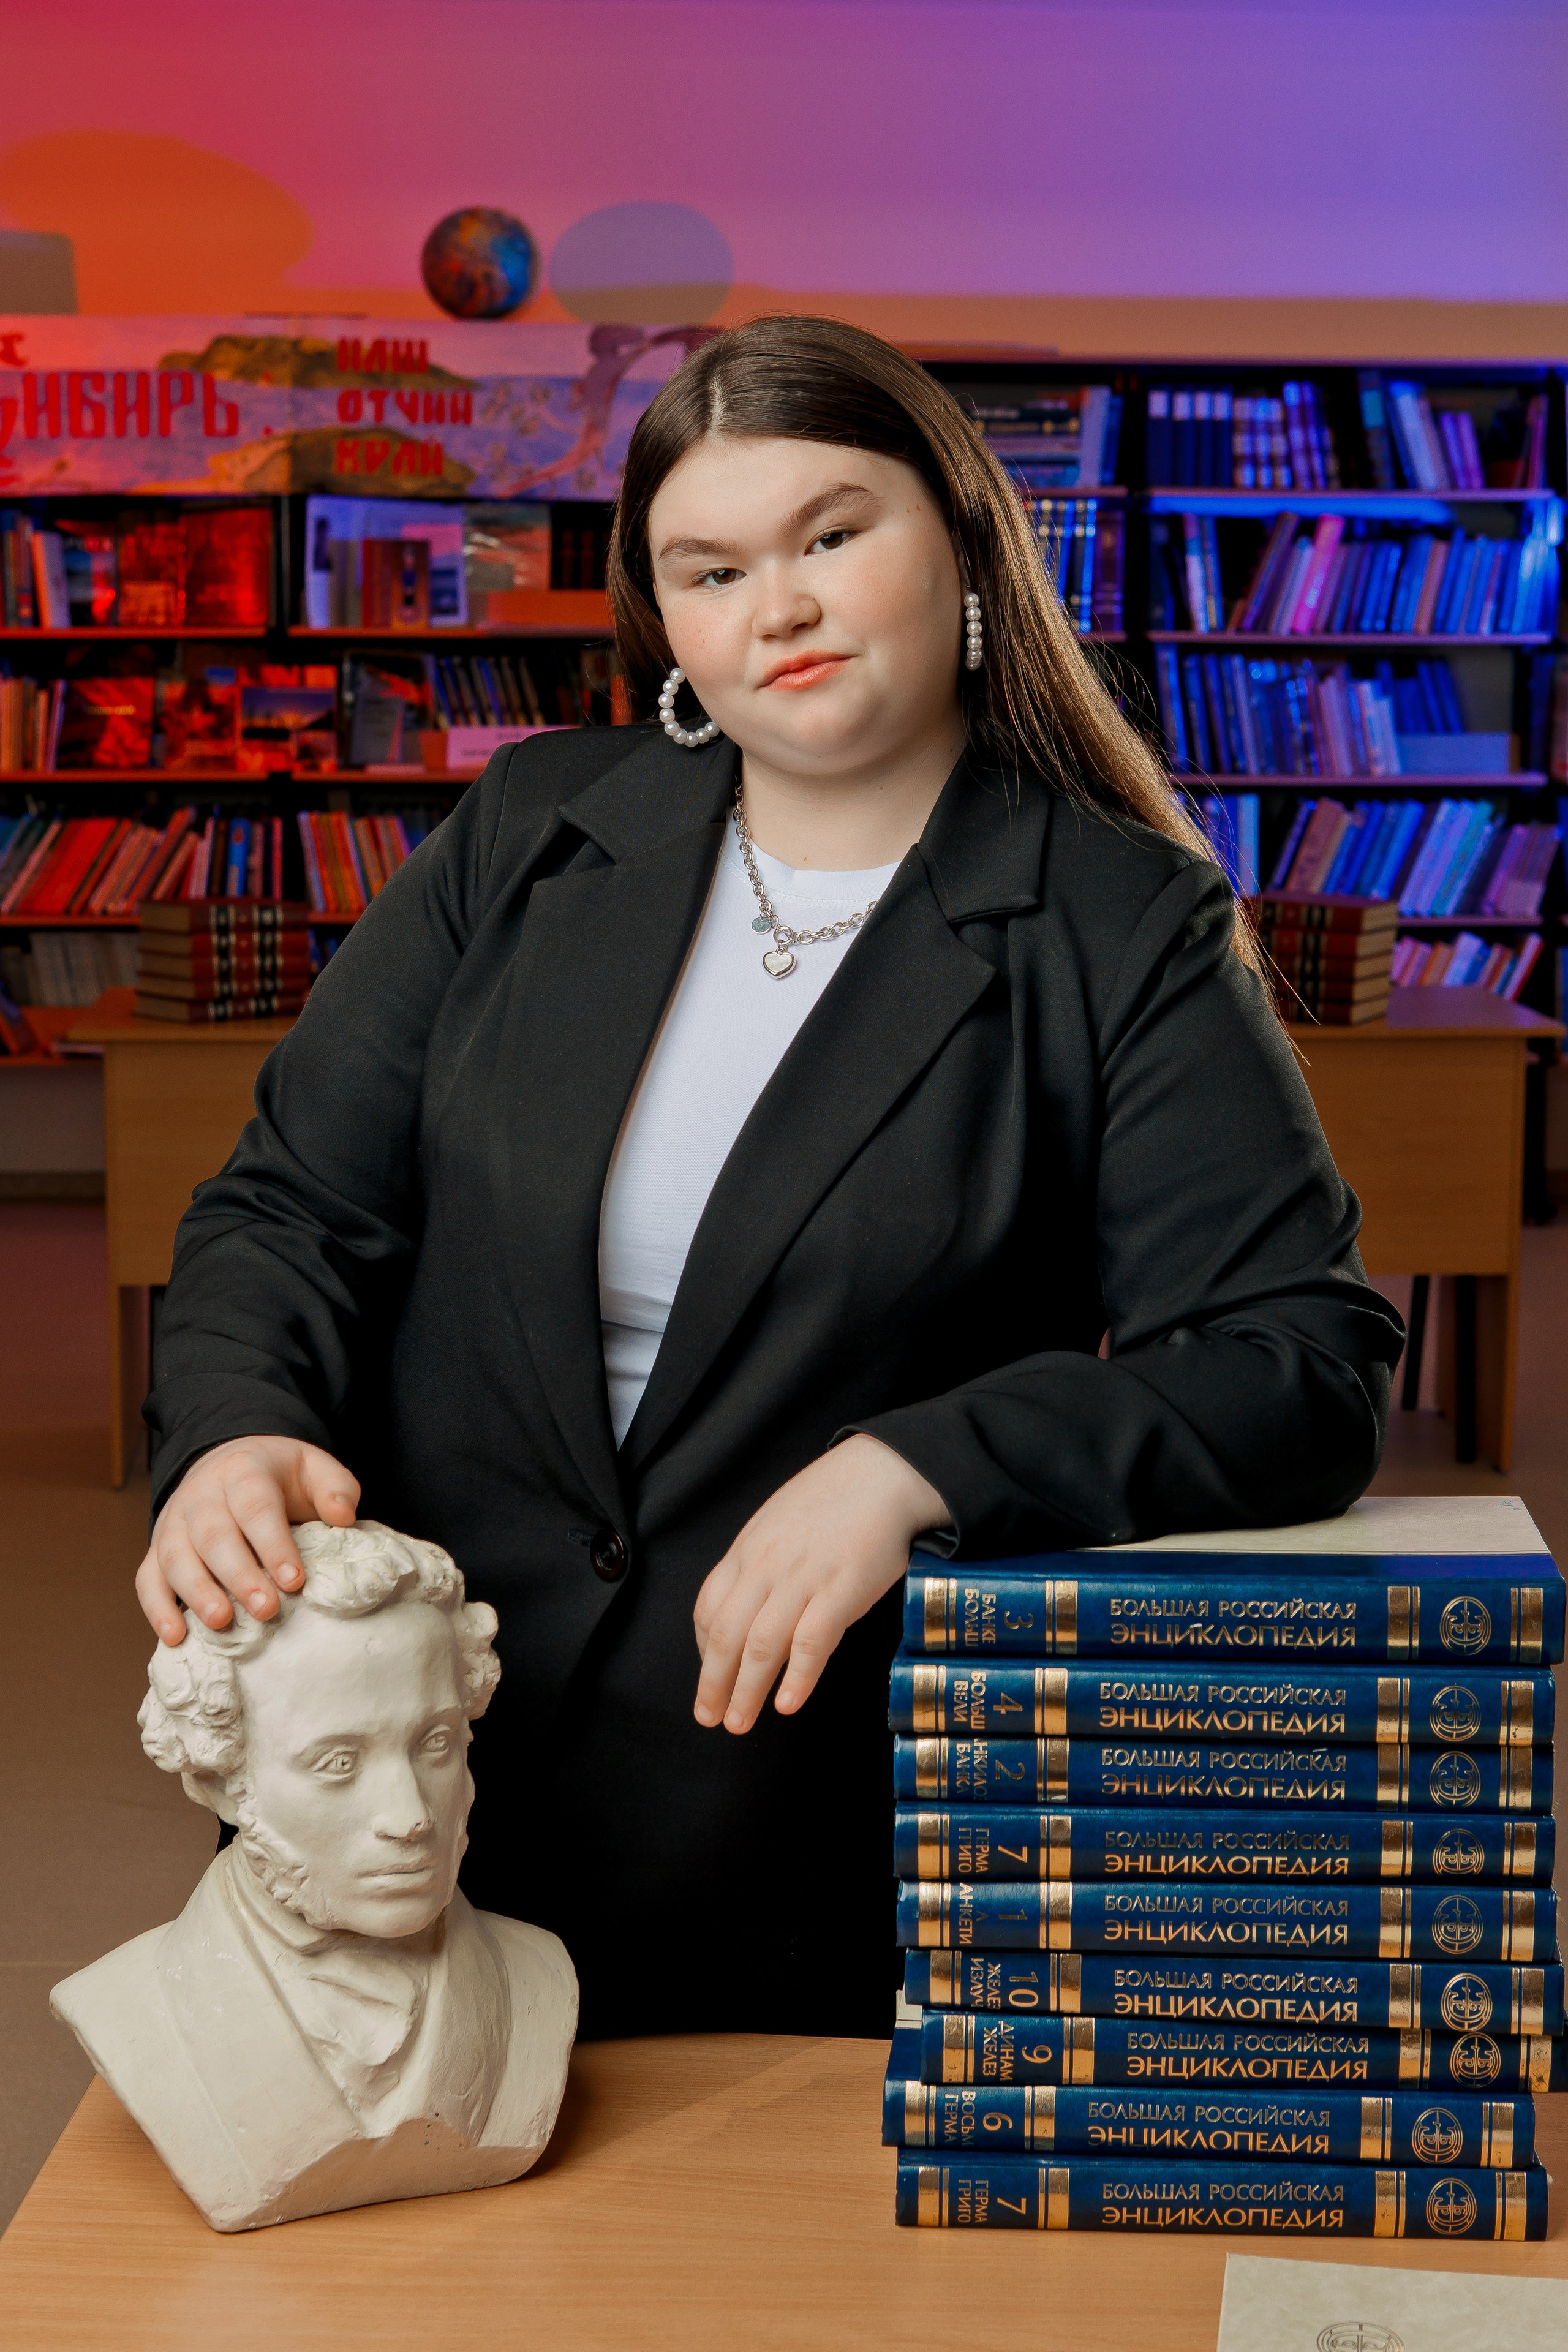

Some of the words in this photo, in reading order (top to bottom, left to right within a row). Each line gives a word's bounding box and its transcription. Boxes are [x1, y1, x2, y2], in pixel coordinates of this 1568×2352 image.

[964, 1588, 979, 1648] БОЛЬШ
[982, 1593, 996, 1644] БАНКЕ
[1004, 1610, 1034, 1629] 3
[1110, 1598, 1209, 1617] БОЛЬШАЯ
[1219, 1598, 1357, 1619] РОССИЙСКАЯ
[1110, 1623, 1356, 1650] ЭНЦИКЛОПЕДИЯ
[954, 1680, 968, 1722] ВЕЛИ
[970, 1670, 986, 1730] БОЛЬШ
[993, 1692, 1023, 1715] 4
[1099, 1682, 1199, 1702] БОЛЬШАЯ
[1208, 1684, 1346, 1706] РОССИЙСКАЯ
[1099, 1706, 1346, 1736] ЭНЦИКЛОПЕДИЯ
[956, 1743, 971, 1794] БАНКА
[974, 1738, 989, 1801] НКИЛО
[995, 1759, 1025, 1781] 2
[1102, 1748, 1200, 1768] БОЛЬШАЯ
[1210, 1750, 1346, 1772] РОССИЙСКАЯ
[1102, 1773, 1346, 1802] ЭНЦИКЛОПЕДИЯ
[958, 1827, 971, 1874] ГРИГО
[976, 1827, 989, 1874] ГЕРМА
[1105, 1831, 1203, 1849] БОЛЬШАЯ
[1213, 1830, 1349, 1850] РОССИЙСКАЯ
[998, 1845, 1028, 1863] 7
[1104, 1855, 1349, 1877] ЭНЦИКЛОПЕДИЯ
[959, 1883, 973, 1945] АНКЕТИ
[998, 1909, 1027, 1920] 1
[1104, 1894, 1202, 1913] БОЛЬШАЯ
[1212, 1895, 1348, 1916] РОССИЙСКАЯ
[1104, 1920, 1348, 1947] ЭНЦИКЛОПЕДИЯ
[970, 1958, 984, 2007] ИЗЛУЧ
[987, 1962, 1001, 2010] ЖЕЛЕЗ
[1009, 1971, 1039, 2008] 10
[1115, 1969, 1212, 1989] БОЛЬШАЯ
[1222, 1972, 1358, 1994] РОССИЙСКАЯ
[1114, 1993, 1357, 2023] ЭНЦИКЛОПЕДИЯ
[982, 2027, 997, 2076] ЖЕЛЕЗ
[998, 2020, 1014, 2081] ДИНАМ
[1022, 2045, 1052, 2064] 9
[1128, 2033, 1224, 2051] БОЛЬШАЯ
[1234, 2032, 1369, 2053] РОССИЙСКАЯ
[1127, 2056, 1368, 2082] ЭНЦИКЛОПЕДИЯ
[944, 2094, 959, 2143] ГЕРМА
[961, 2090, 976, 2146] ВОСЬМ
[982, 2112, 1013, 2131] 6
[1088, 2102, 1185, 2122] БОЛЬШАЯ
[1195, 2105, 1330, 2127] РОССИЙСКАЯ
[1088, 2126, 1329, 2154] ЭНЦИКЛОПЕДИЯ
[958, 2179, 971, 2223] ГРИГО
[974, 2180, 988, 2223] ГЕРМА
[1102, 2184, 1199, 2200] БОЛЬШАЯ
[1210, 2180, 1344, 2201] РОССИЙСКАЯ
[997, 2198, 1027, 2215] 7
[1102, 2207, 1343, 2229] ЭНЦИКЛОПЕДИЯ
